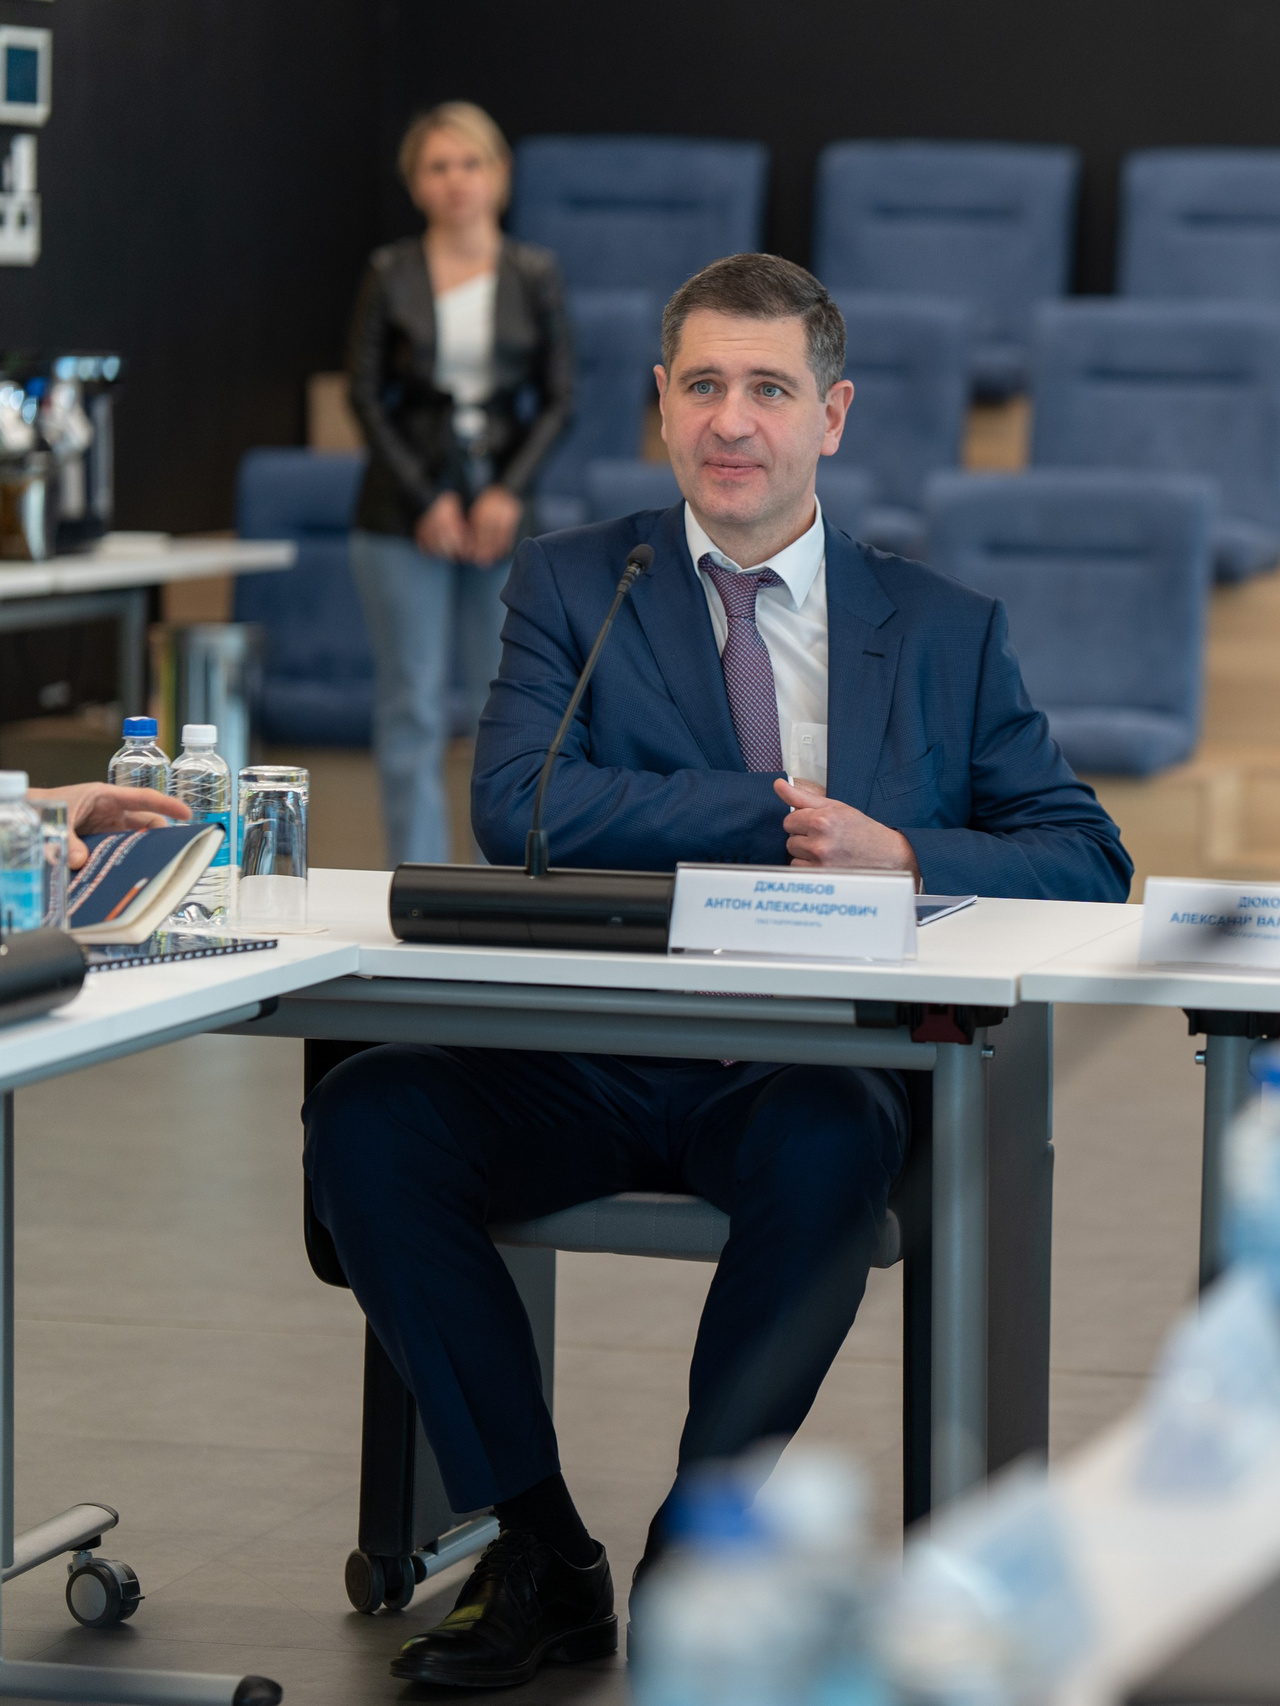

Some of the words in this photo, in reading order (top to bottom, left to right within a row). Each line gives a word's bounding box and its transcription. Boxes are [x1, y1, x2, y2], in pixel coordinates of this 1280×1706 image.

[754, 881, 835, 895] ДЖАЛЯБОВ
[704, 897, 752, 910] АНТОН
[755, 899, 878, 917] АЛЕКСАНДРОВИЧ
